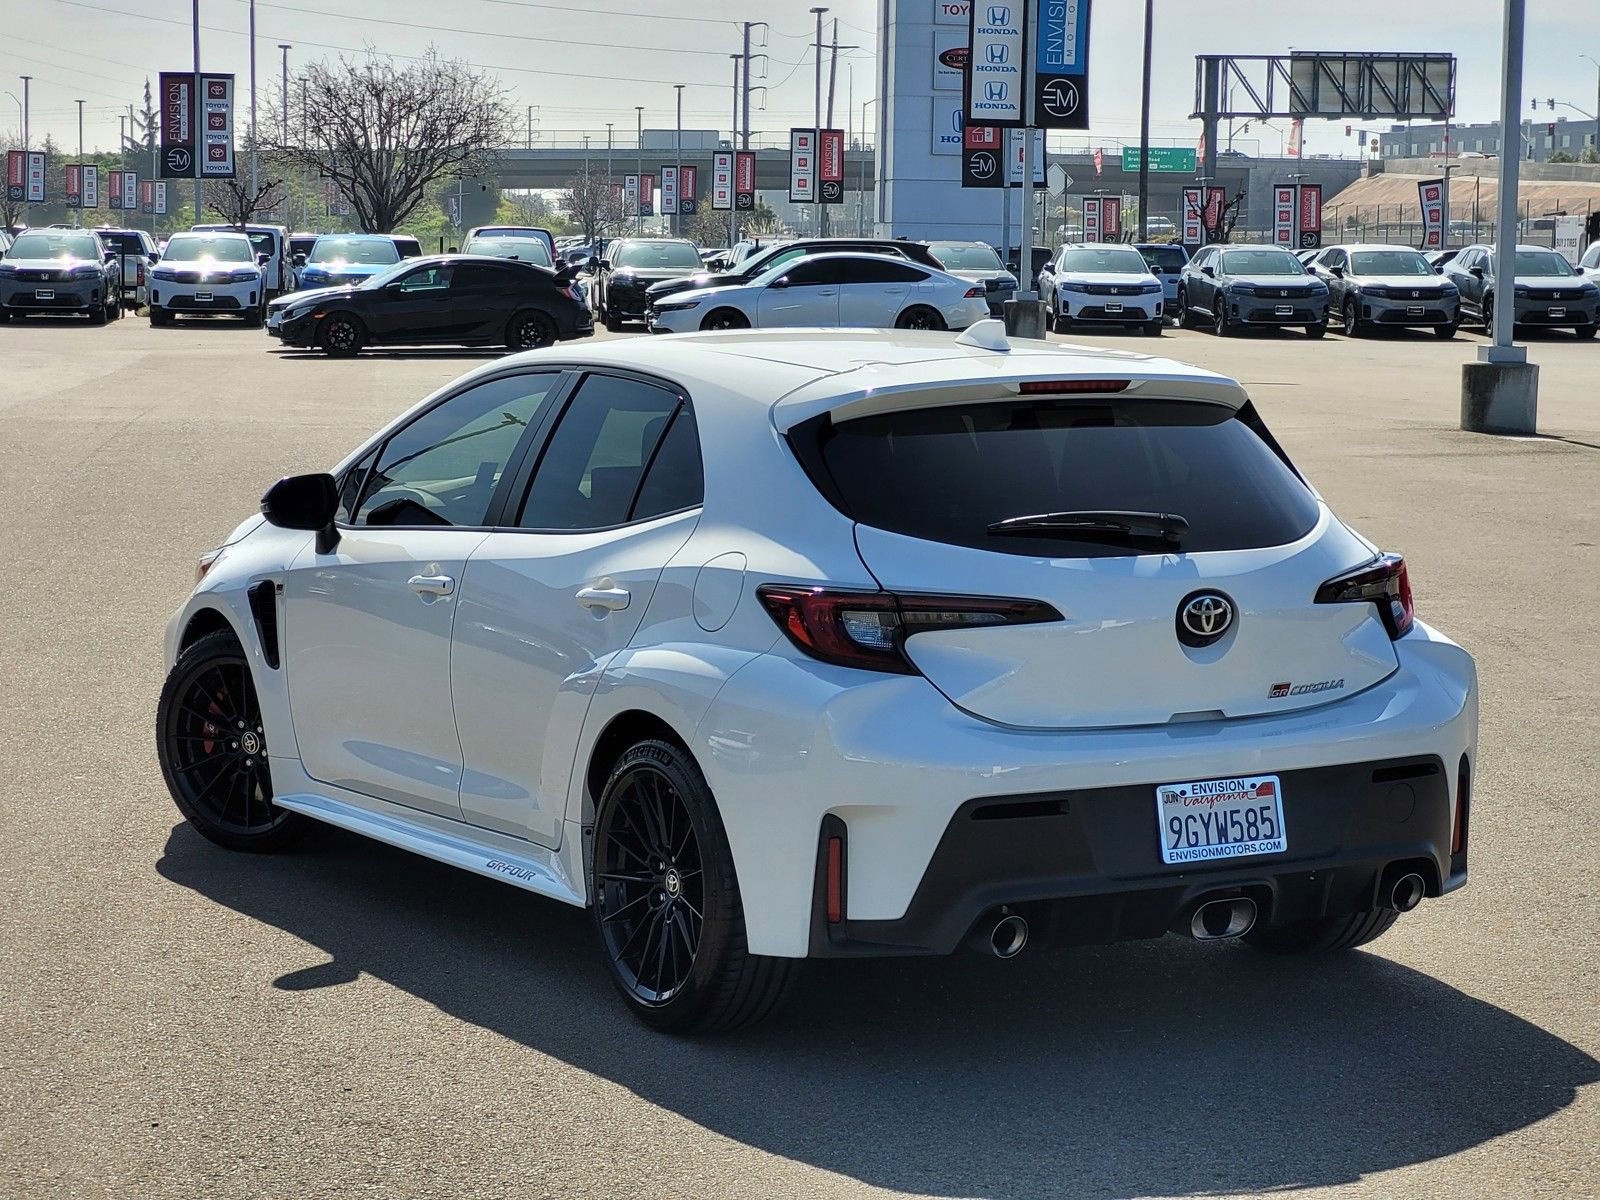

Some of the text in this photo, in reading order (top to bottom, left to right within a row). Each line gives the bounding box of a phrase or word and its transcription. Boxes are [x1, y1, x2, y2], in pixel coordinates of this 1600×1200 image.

[942, 4, 969, 15] TOY
[1046, 0, 1064, 64] ENVISI
[1066, 5, 1075, 57] MOTO
[170, 83, 179, 139] ENVISION
[1271, 678, 1346, 697] GR COROLLA
[627, 746, 670, 764] MICHELIN
[1192, 780, 1245, 795] ENVISION
[1164, 795, 1178, 804] JUN
[1183, 792, 1248, 809] California
[1169, 806, 1275, 849] 9GYW585
[1170, 842, 1281, 860] ENVISIONMOTORS.COM
